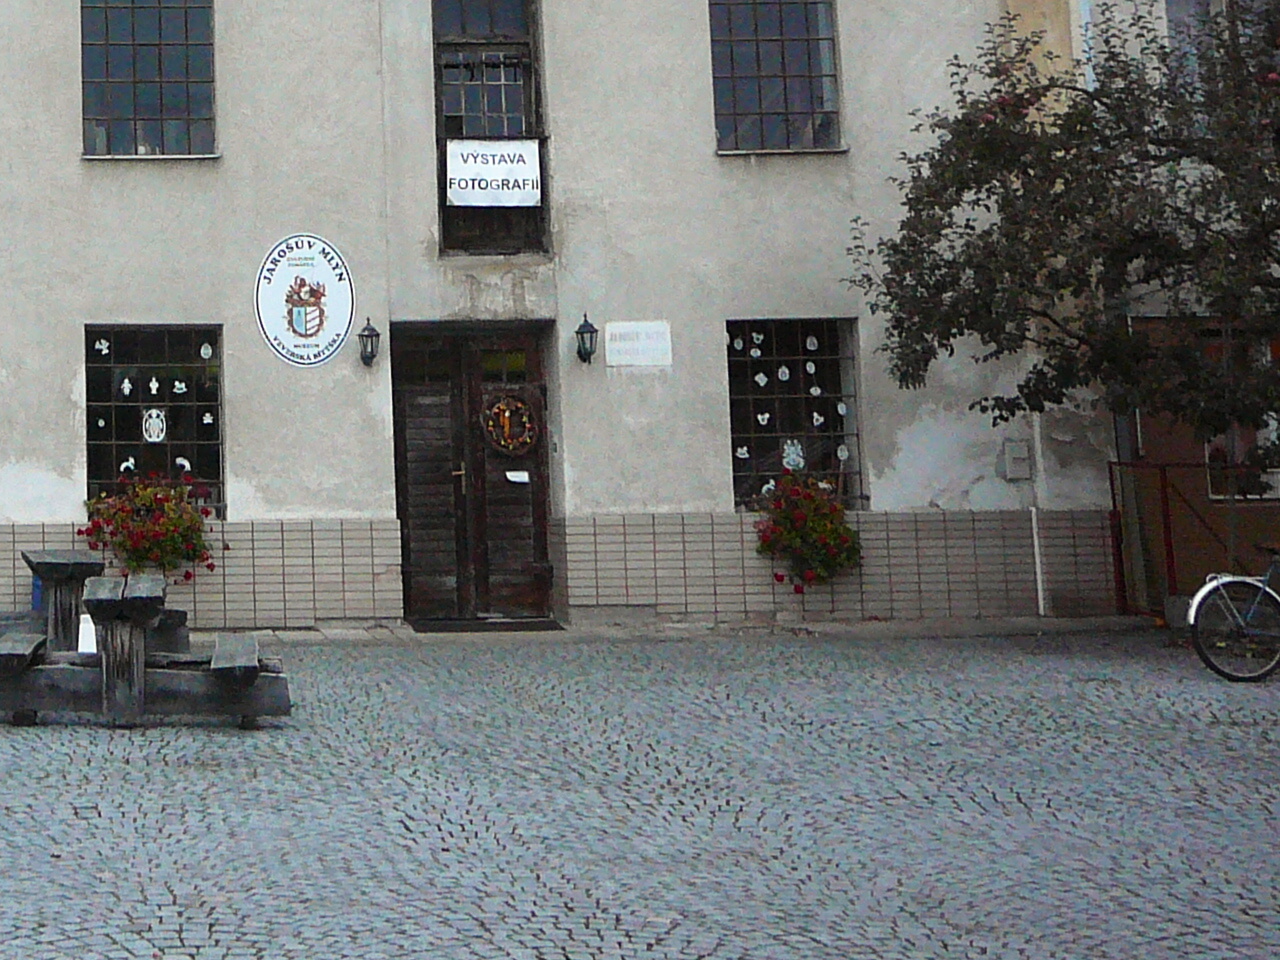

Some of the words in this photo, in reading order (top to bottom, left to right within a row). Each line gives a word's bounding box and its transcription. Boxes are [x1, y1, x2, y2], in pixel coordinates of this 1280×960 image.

[460, 149, 527, 165] VÝSTAVA
[449, 176, 539, 191] FOTOGRAFIÍ
[263, 238, 316, 285] JAROŠŮV
[318, 247, 347, 283] MLÝN
